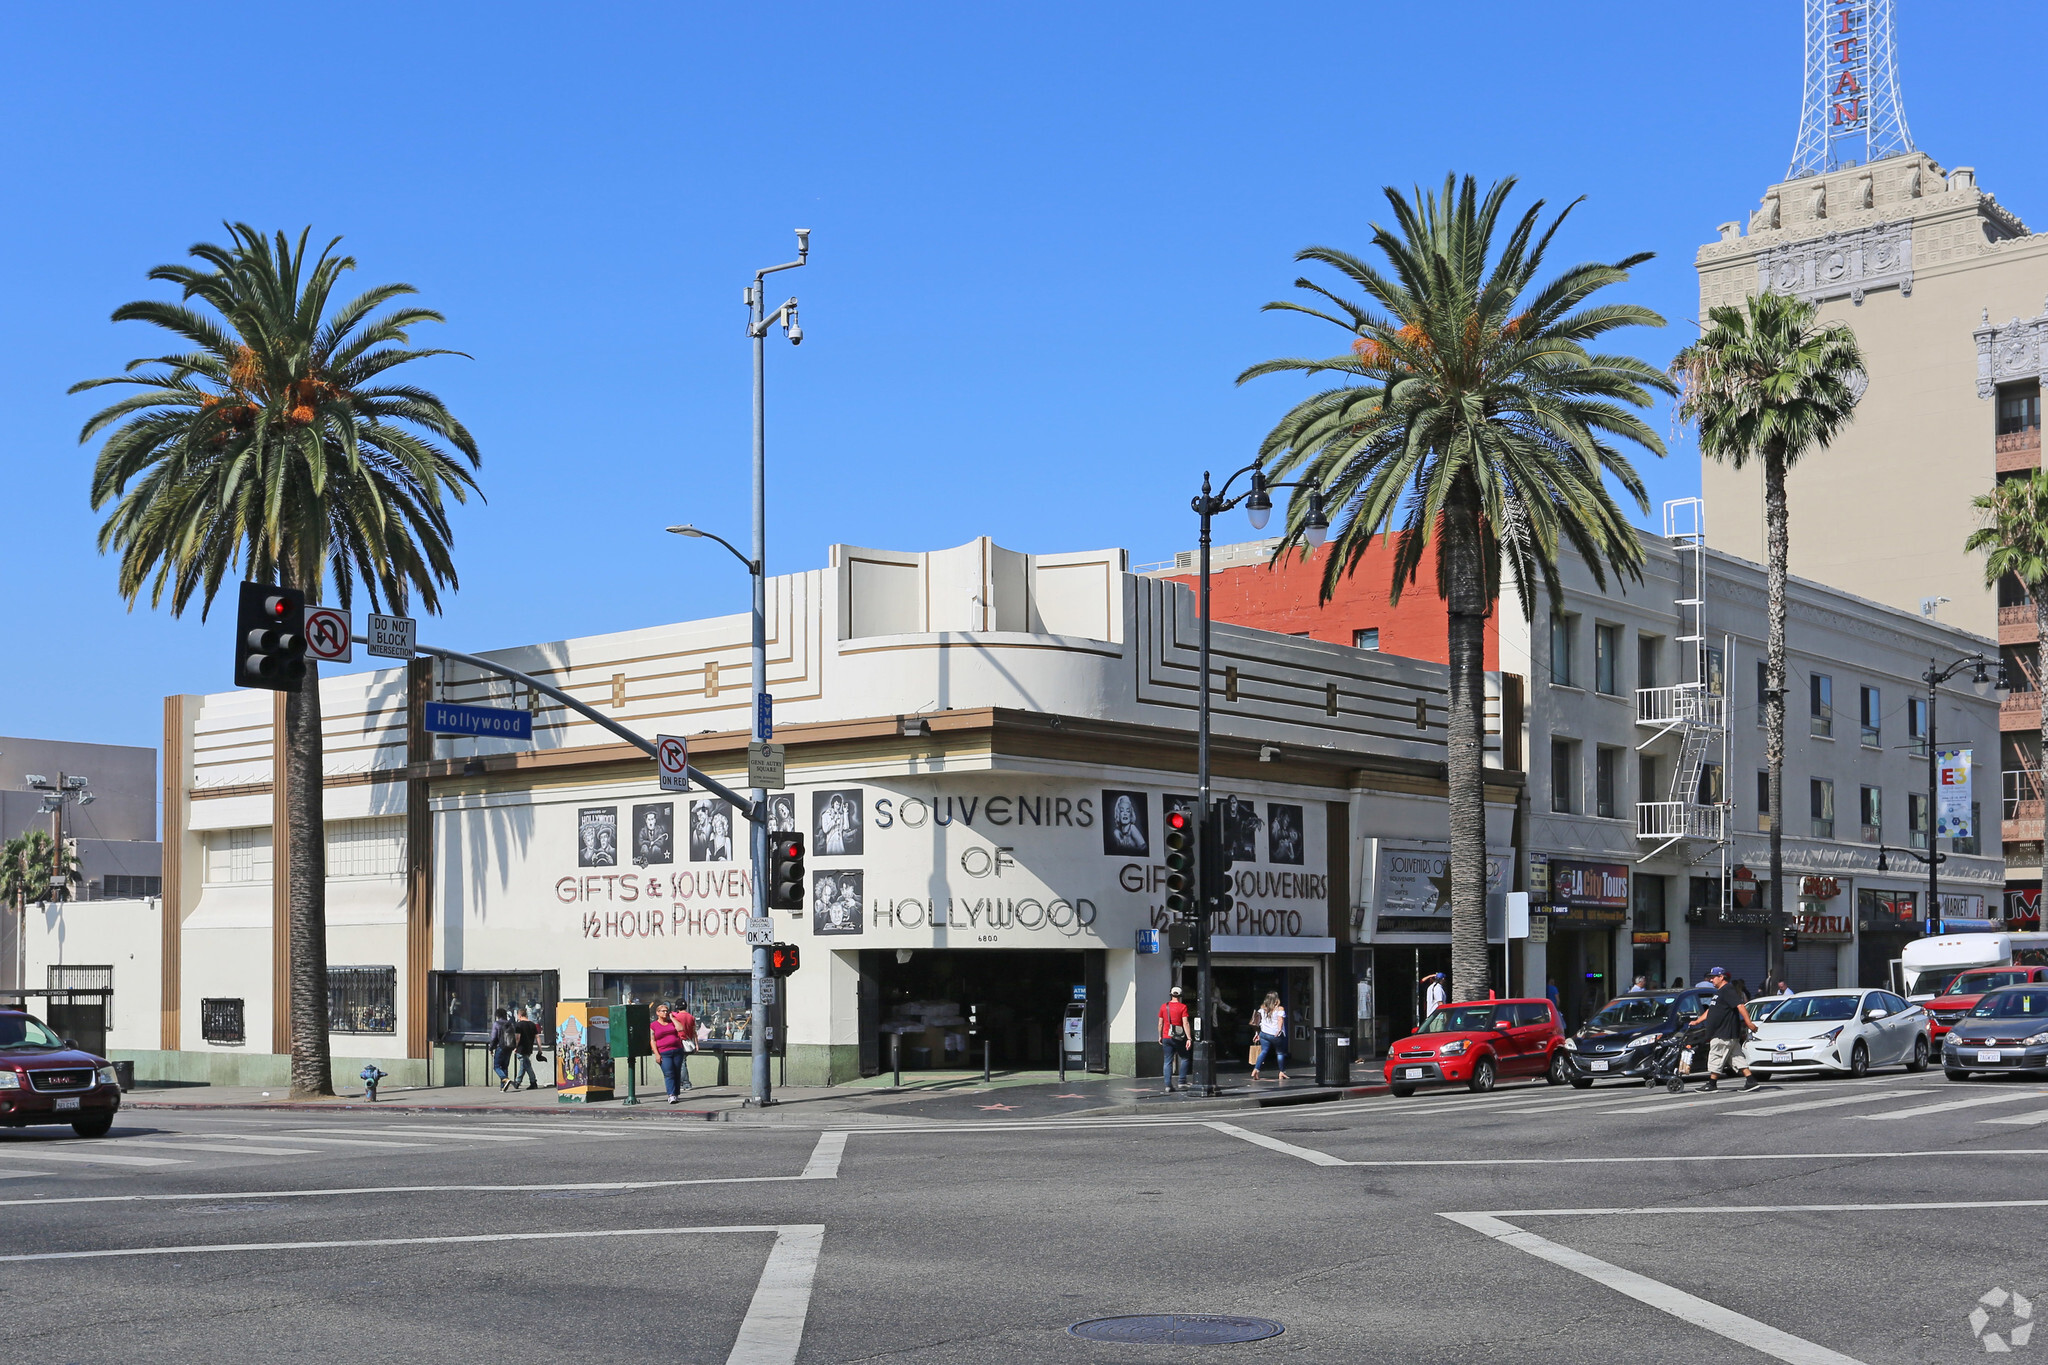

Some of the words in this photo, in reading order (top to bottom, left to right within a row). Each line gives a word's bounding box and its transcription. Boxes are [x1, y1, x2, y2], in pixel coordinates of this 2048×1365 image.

[1832, 0, 1861, 126] ITAN
[374, 617, 388, 630] DO
[392, 620, 410, 634] NOT
[376, 632, 407, 646] BLOCK
[370, 644, 413, 657] INTERSECTION
[437, 709, 520, 732] Hollywood
[662, 775, 672, 786] ON
[673, 777, 687, 787] RED
[1941, 767, 1967, 786] E3
[581, 814, 615, 826] HOLLYWOOD
[875, 796, 1094, 829] SOUVENIRS
[961, 847, 1014, 878] OF
[1391, 857, 1431, 875] SOUVENIRS
[555, 873, 640, 904] GIFTS
[646, 877, 663, 898] &
[671, 869, 753, 901] SOUVEN
[1119, 863, 1166, 893] GIF
[1235, 870, 1328, 900] SOUVENIRS
[1572, 869, 1583, 896] LA
[1583, 868, 1601, 899] City
[1602, 871, 1628, 898] Tours
[872, 897, 1097, 931] HOLLYWOOD
[1534, 905, 1541, 913] LA
[1541, 905, 1553, 914] City
[1552, 905, 1569, 913] Tours
[605, 909, 665, 938] HOUR
[672, 902, 752, 938] PHOTO
[1236, 901, 1303, 937] PHOTO
[747, 931, 759, 942] OK
[1139, 929, 1158, 943] ATM
[1140, 943, 1158, 952] INSIDE
[789, 950, 798, 966] 5
